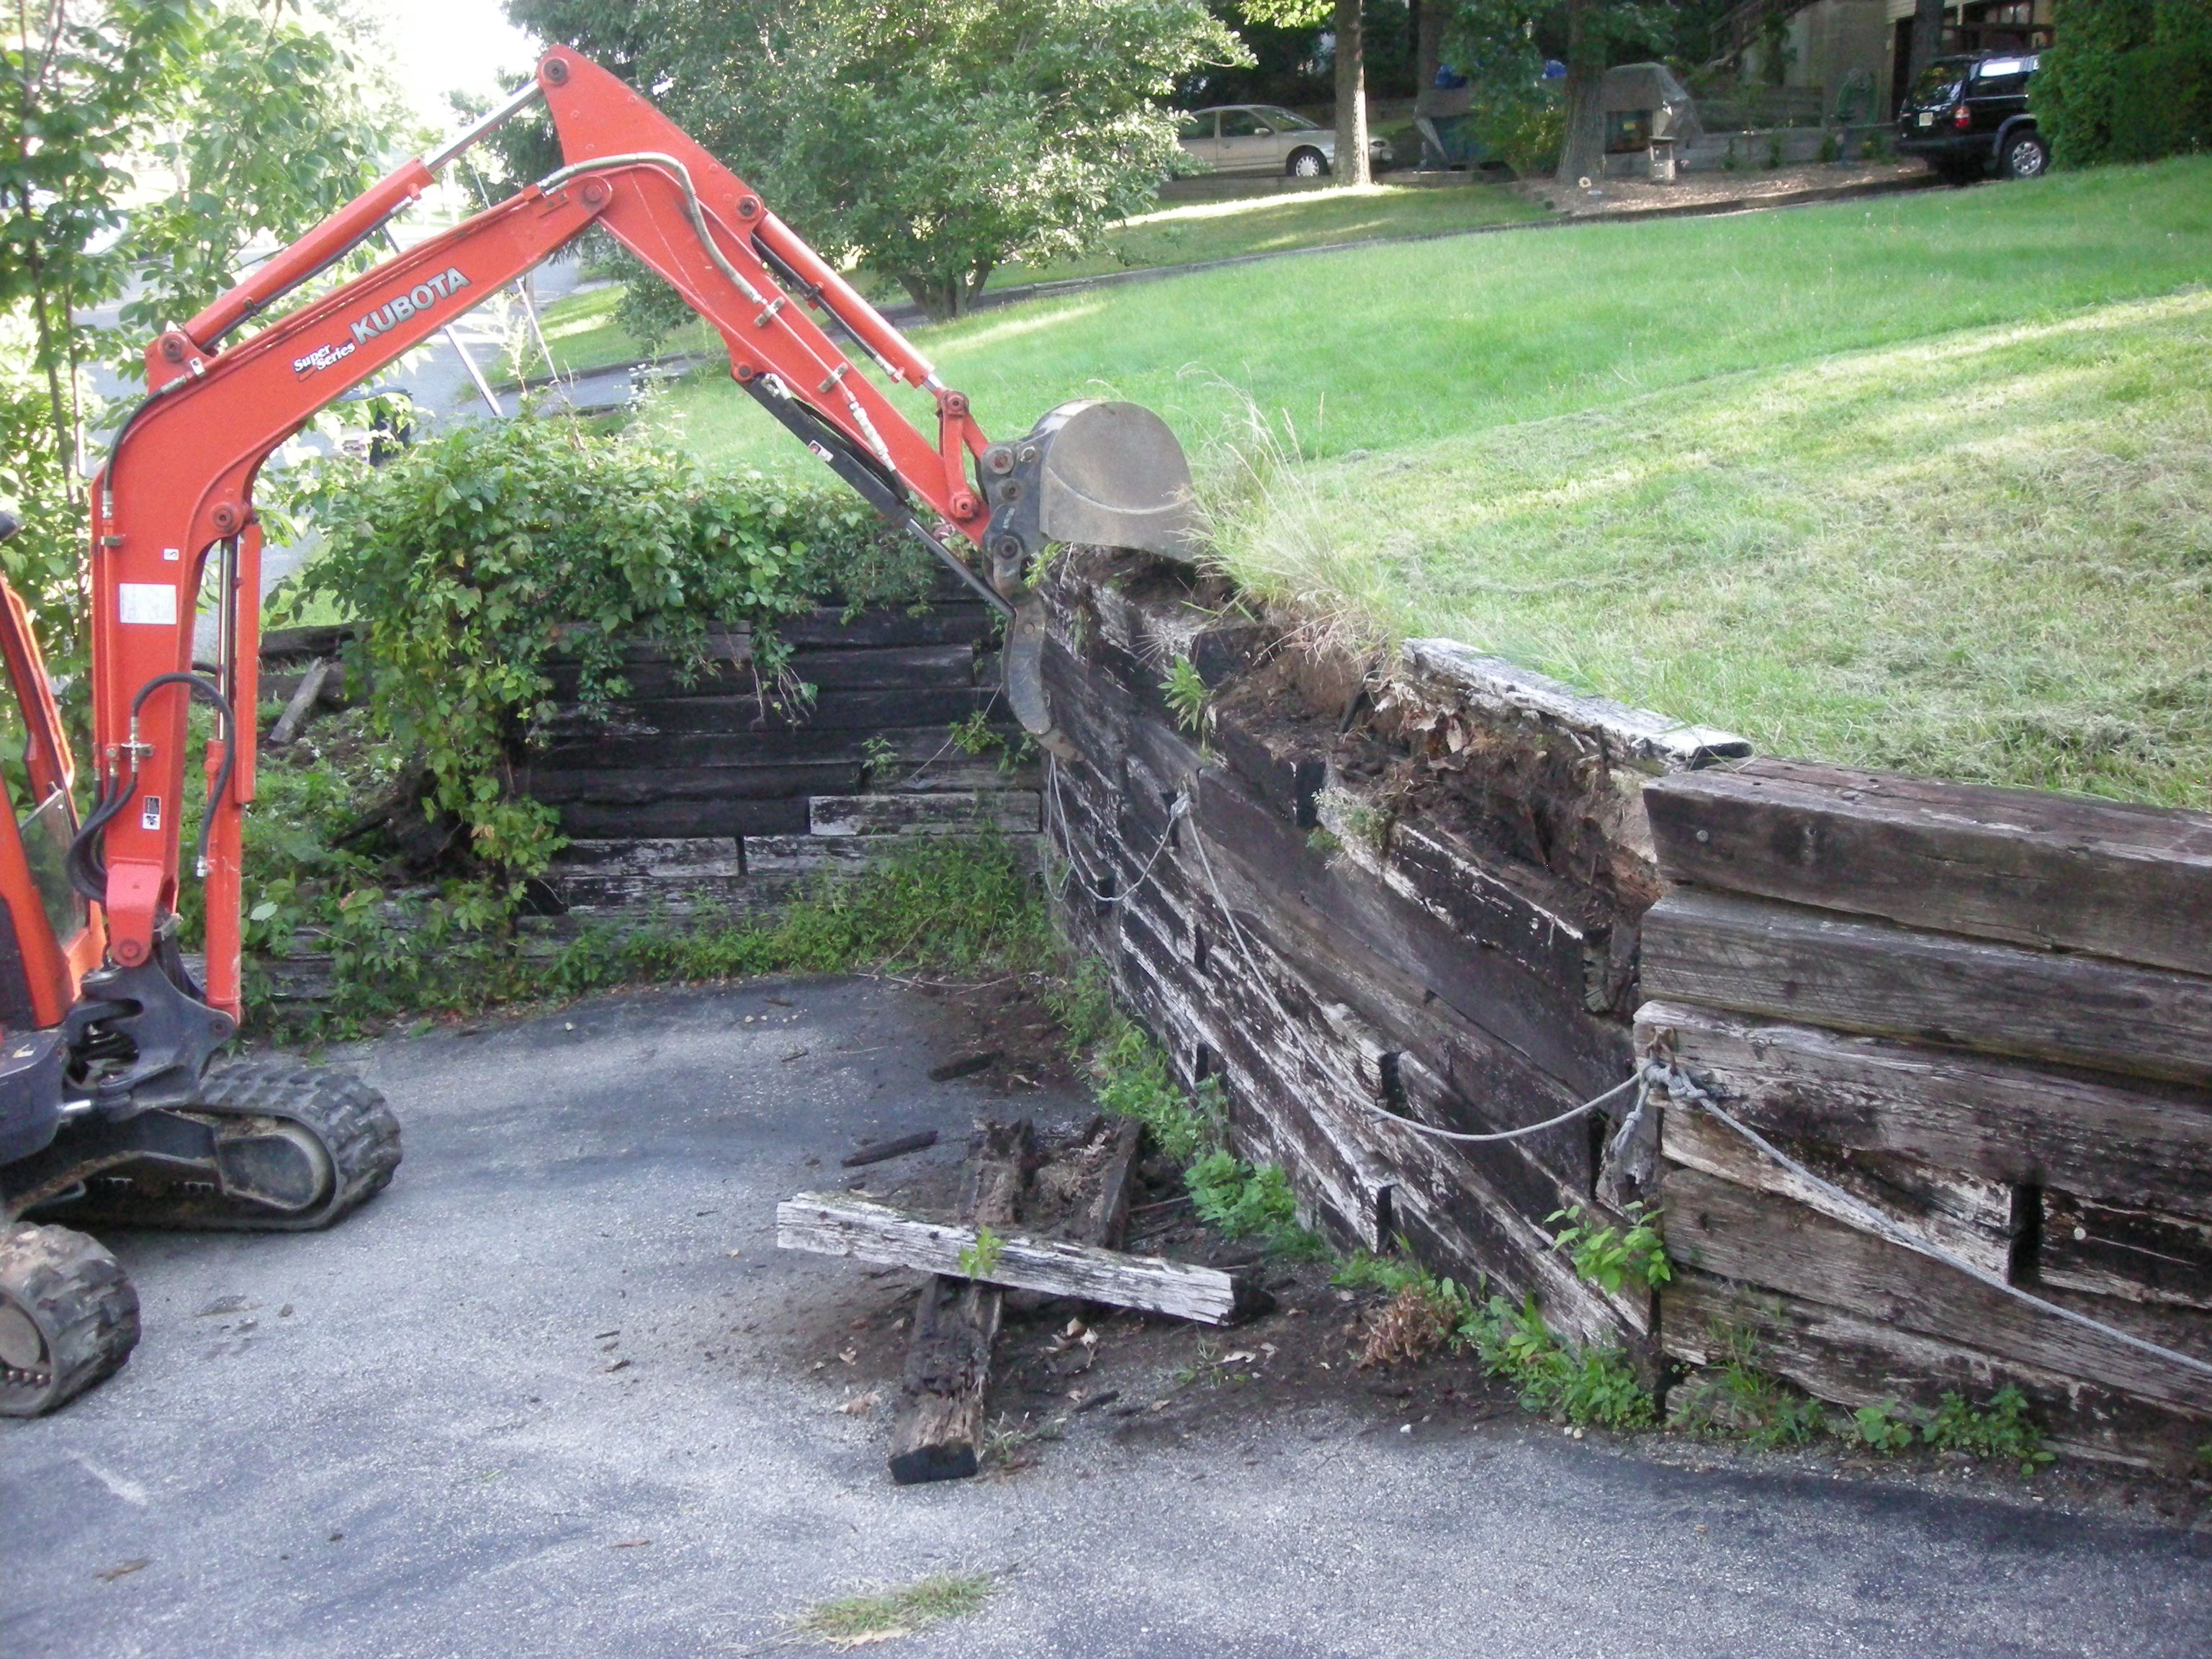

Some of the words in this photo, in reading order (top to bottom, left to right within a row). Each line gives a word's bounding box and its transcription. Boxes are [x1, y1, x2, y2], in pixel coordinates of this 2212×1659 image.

[349, 266, 472, 344] KUBOTA
[294, 344, 331, 372] Super
[316, 342, 356, 370] Series
